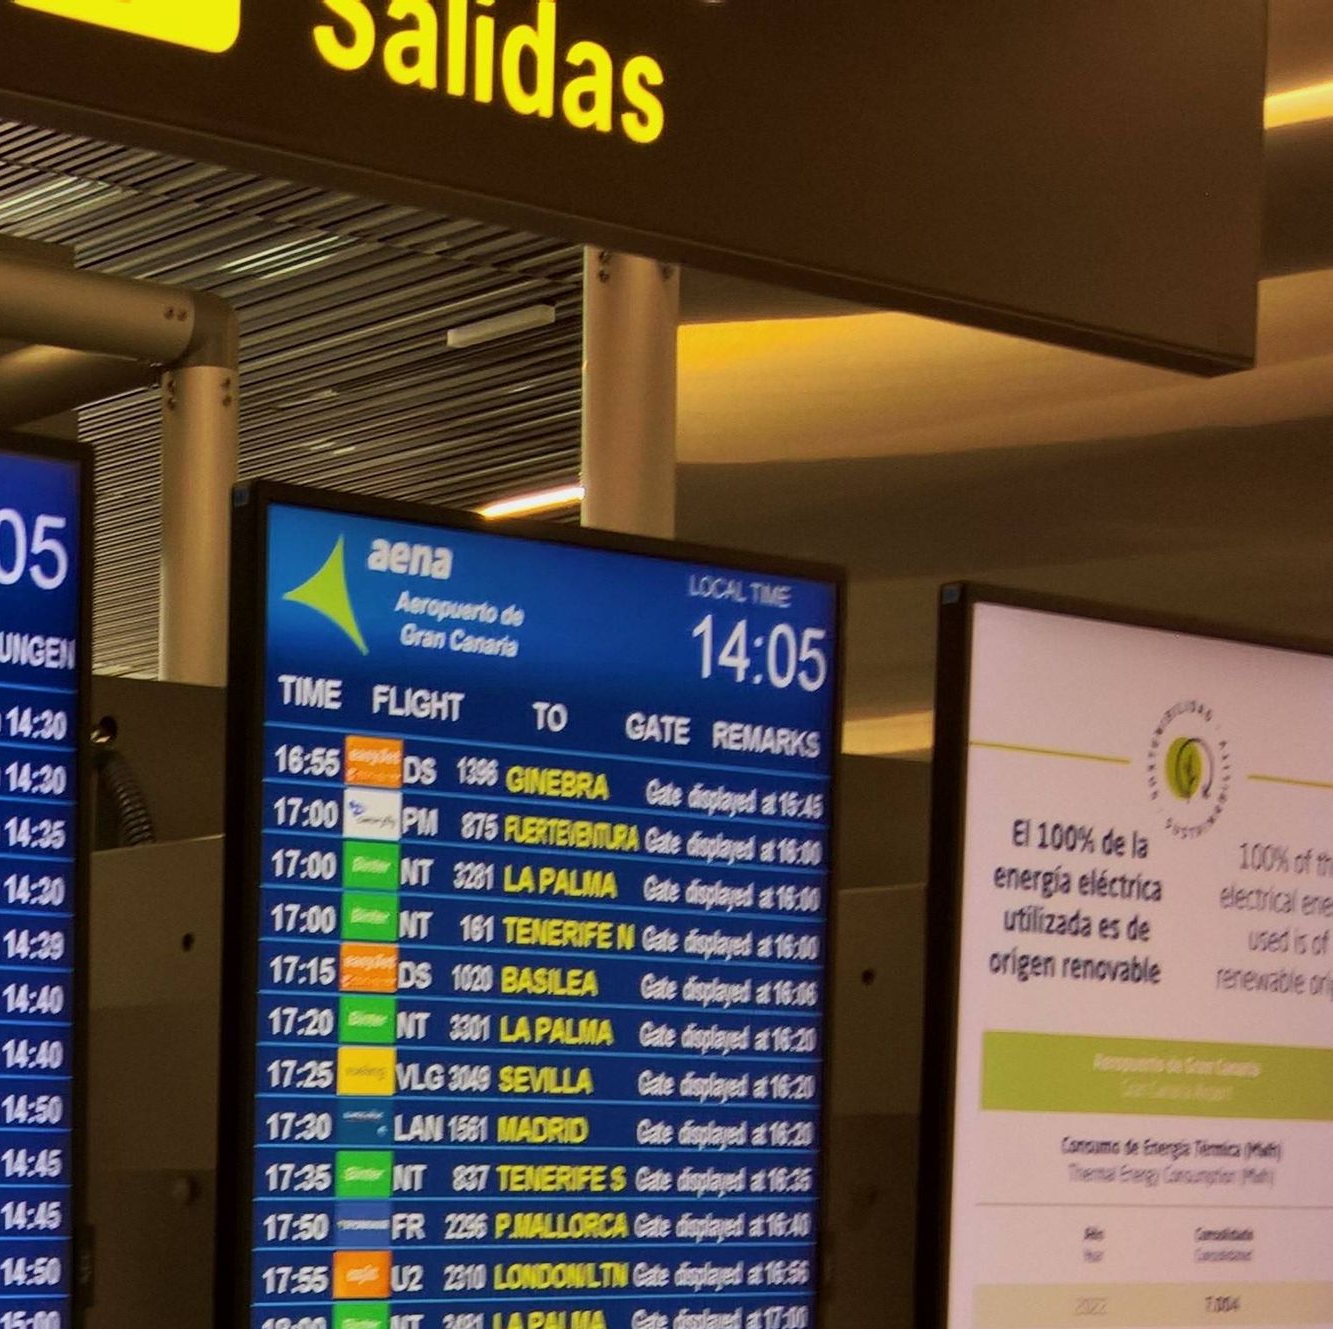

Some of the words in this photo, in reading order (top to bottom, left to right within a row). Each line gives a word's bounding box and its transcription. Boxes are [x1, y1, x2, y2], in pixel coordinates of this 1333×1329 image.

[313, 0, 666, 145] Salidas
[366, 537, 454, 581] aena
[394, 589, 499, 625] Aeropuerto
[499, 603, 525, 628] de
[689, 575, 748, 603] LOCAL
[749, 581, 791, 609] TIME
[399, 622, 447, 650] Gran
[448, 627, 519, 658] Canaria
[691, 613, 827, 693] 14:05
[277, 673, 343, 711] TIME
[371, 683, 466, 723] FLIGHT
[531, 700, 569, 733] TO
[624, 711, 692, 746] GATE
[711, 720, 821, 759] REMARKS
[1012, 818, 1030, 847] El
[1037, 821, 1096, 854] 100%
[1102, 826, 1126, 857] de
[1131, 829, 1149, 859] la
[1239, 842, 1289, 872] 100%
[270, 848, 338, 881] 17:00
[684, 878, 755, 913] displayed
[993, 864, 1071, 899] energía
[1078, 867, 1163, 902] eléctrica
[1003, 903, 1092, 938] utilizada
[1098, 915, 1121, 940] es
[1126, 914, 1151, 942] de
[988, 946, 1055, 982] origen
[1062, 955, 1162, 984] renovable
[2, 982, 64, 1015] 14:40
[0, 1147, 62, 1179] 14:45
